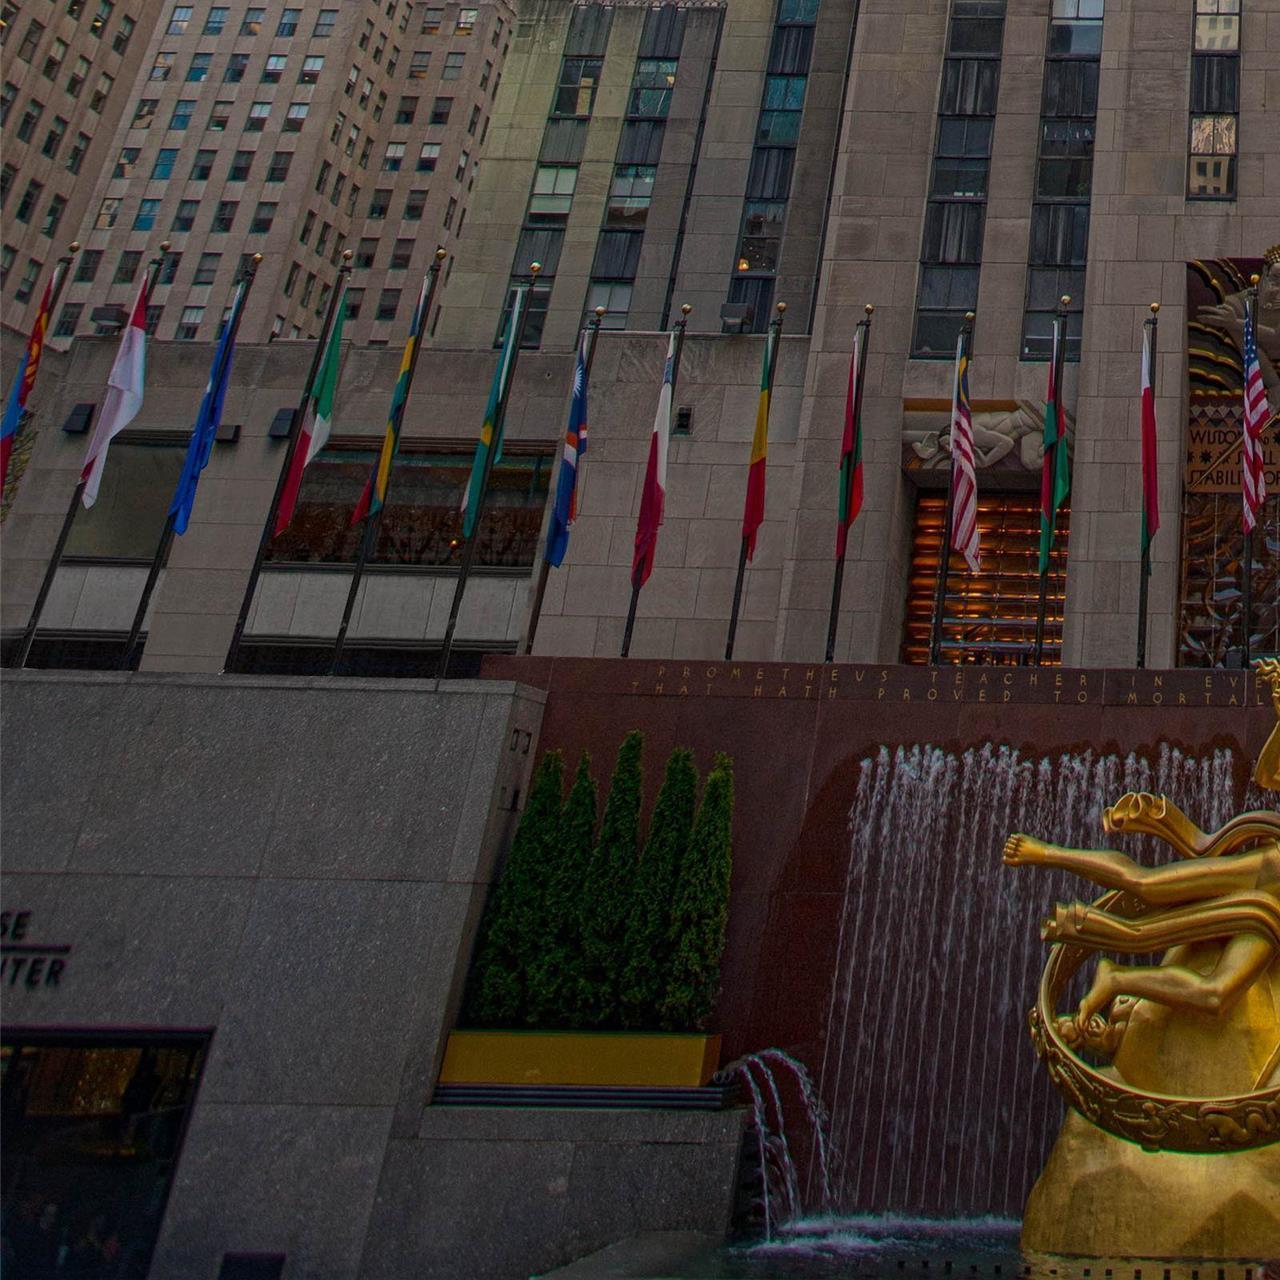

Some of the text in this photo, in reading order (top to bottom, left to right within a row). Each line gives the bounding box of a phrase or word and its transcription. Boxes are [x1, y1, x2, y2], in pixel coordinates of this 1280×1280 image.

[1235, 450, 1276, 466] SLL
[1187, 470, 1244, 486] STABILI
[931, 671, 1088, 687] TEACHER
[1131, 675, 1163, 688] IN
[631, 681, 714, 696] THAT
[754, 684, 837, 699] HATH
[877, 687, 1012, 703] PROVED
[1053, 690, 1088, 704] TO
[1125, 692, 1265, 706] MORTAL
[0, 958, 65, 986] TER
